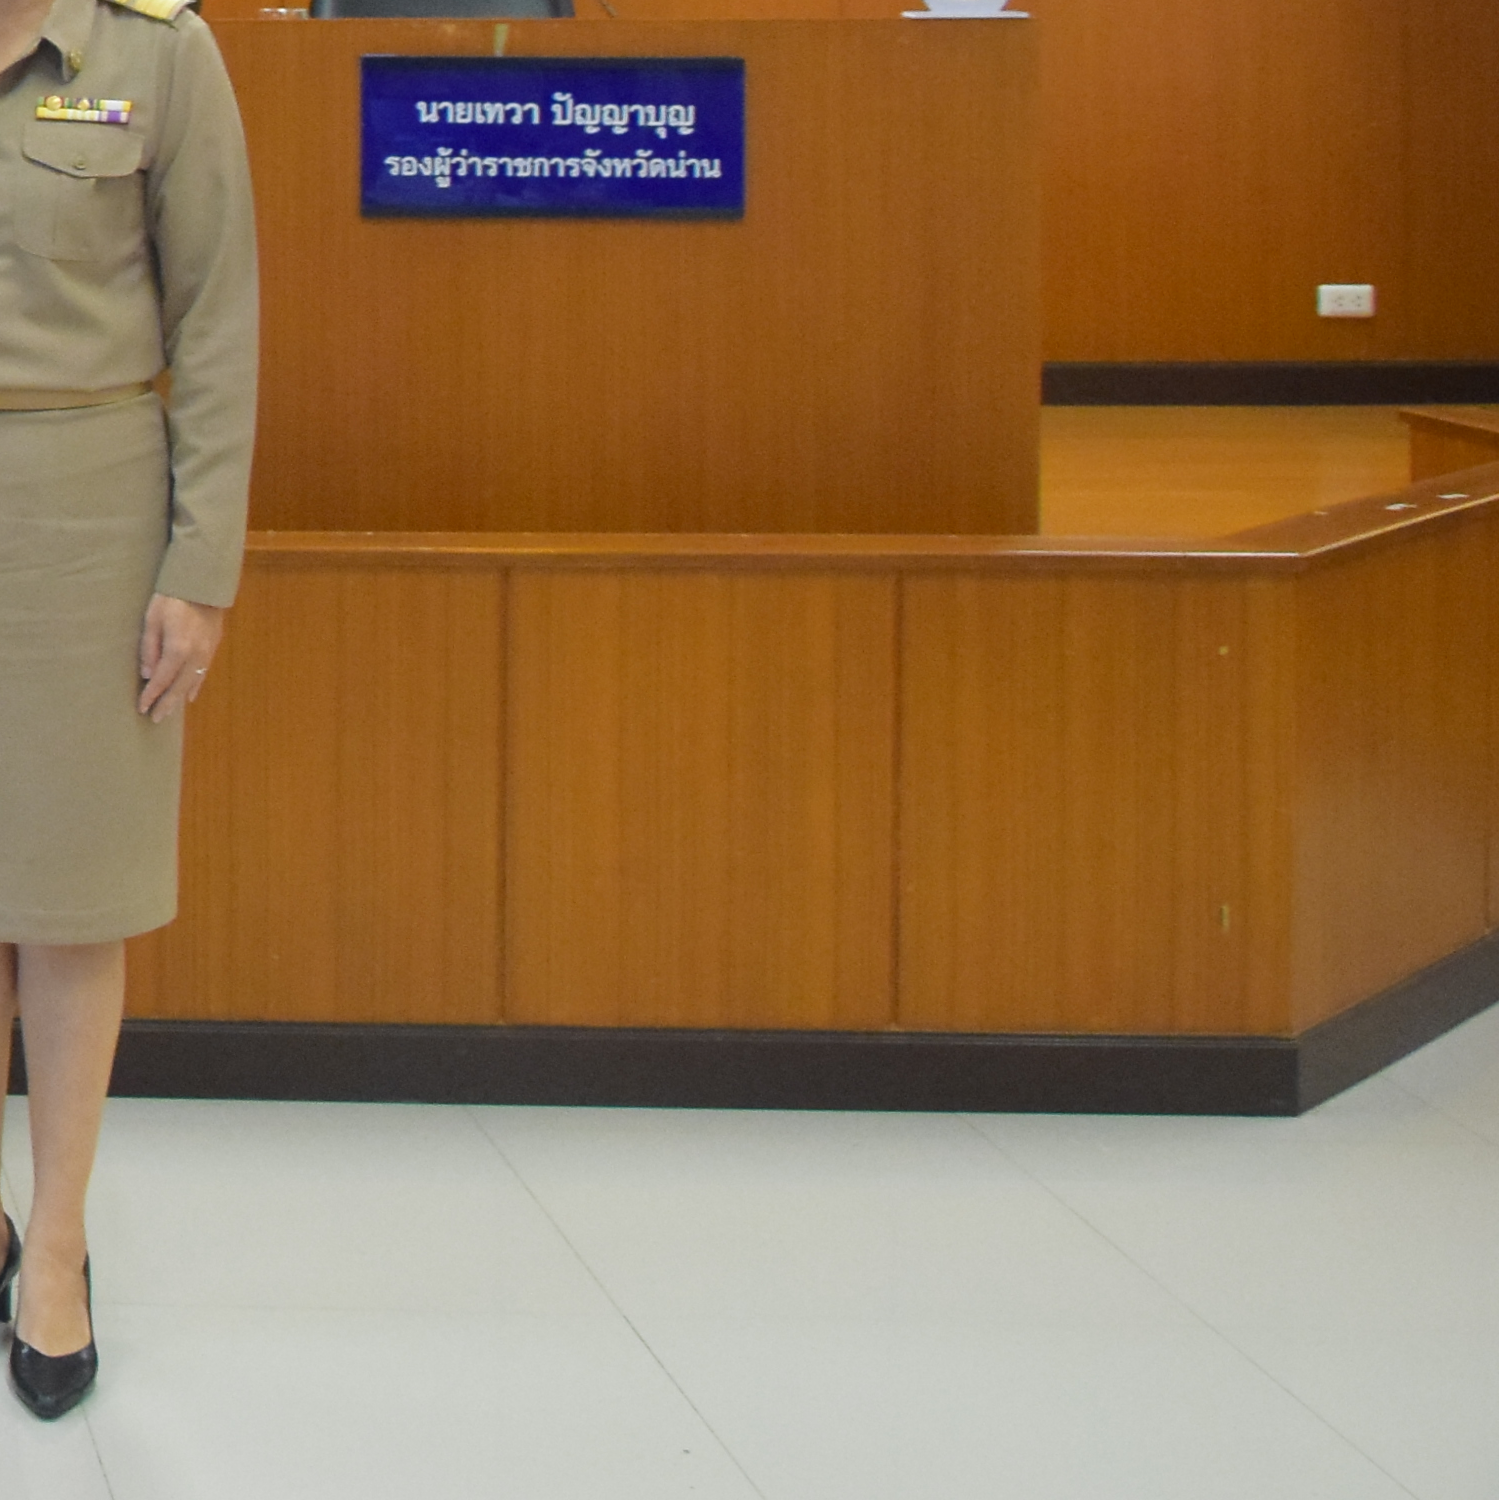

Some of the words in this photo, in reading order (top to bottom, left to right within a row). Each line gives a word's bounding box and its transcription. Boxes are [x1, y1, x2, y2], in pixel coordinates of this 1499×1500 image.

[415, 100, 540, 124] นายเทวา
[551, 92, 696, 138] ปัญญาบุญ
[384, 146, 722, 188] รองผู้ว่าราชการจังหวัดน่าน
